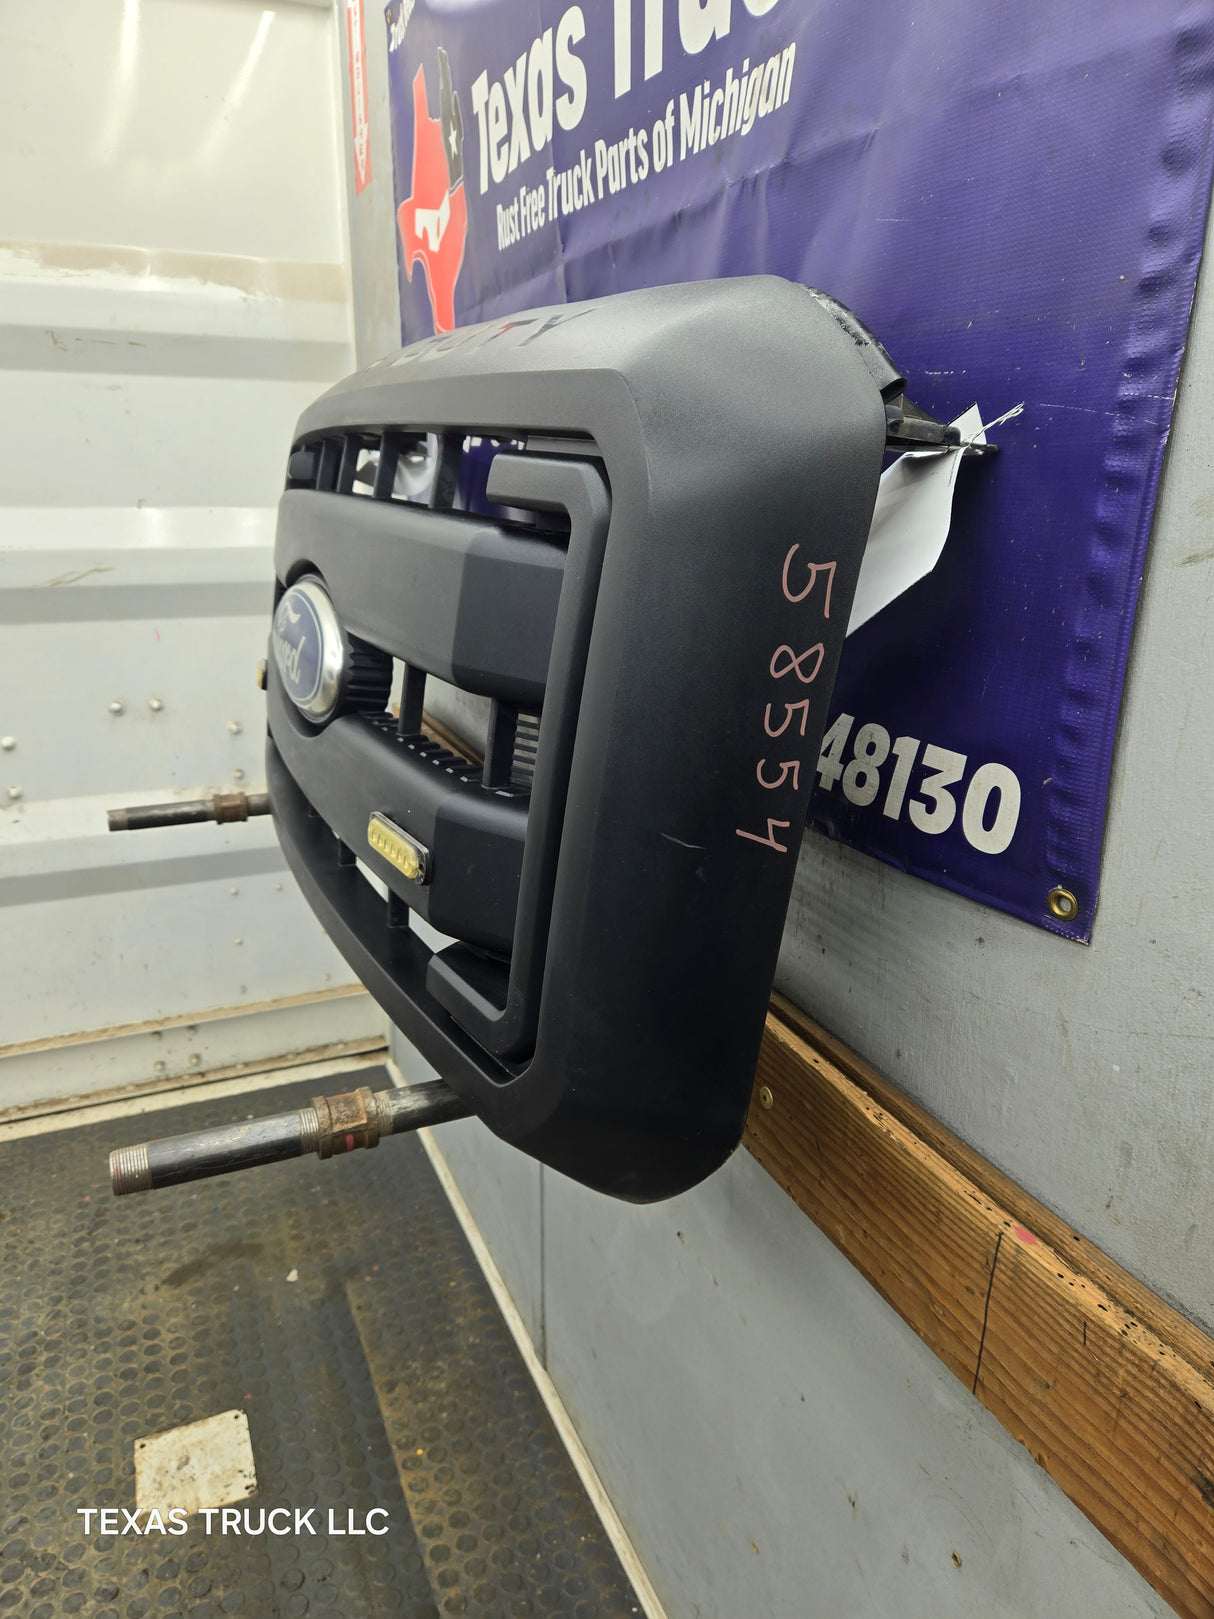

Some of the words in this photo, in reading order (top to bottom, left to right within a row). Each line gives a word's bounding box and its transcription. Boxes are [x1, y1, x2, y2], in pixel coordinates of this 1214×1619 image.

[471, 6, 587, 195] Texas
[496, 196, 520, 251] Rust
[520, 184, 545, 237] Free
[546, 166, 595, 222] Truck
[594, 127, 649, 200] Parts
[652, 98, 675, 173] of
[679, 41, 796, 162] Michigan
[816, 712, 1022, 855] 48130
